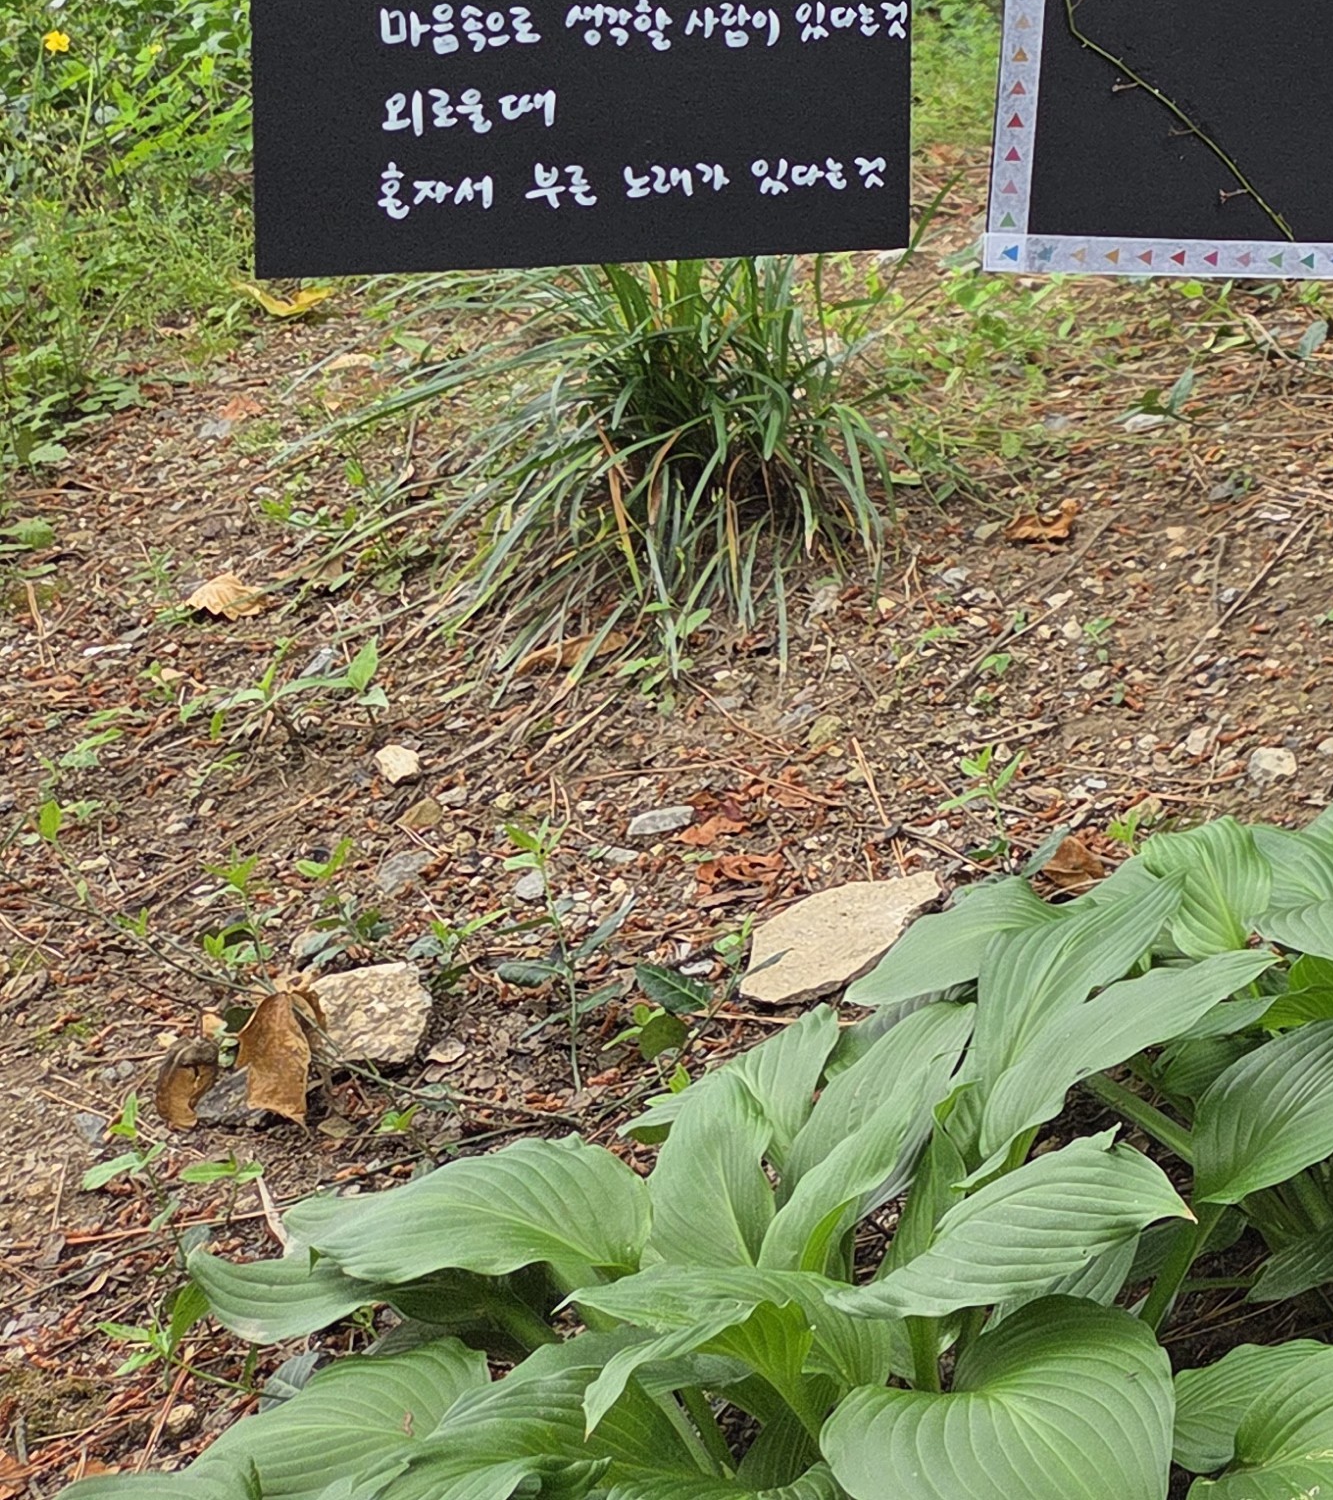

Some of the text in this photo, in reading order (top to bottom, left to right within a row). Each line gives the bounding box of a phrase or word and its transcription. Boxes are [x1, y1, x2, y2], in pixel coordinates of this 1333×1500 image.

[379, 3, 542, 55] 마음속으로
[684, 4, 781, 48] 사람이
[377, 161, 494, 220] 혼자서
[623, 162, 730, 198] 노래가
